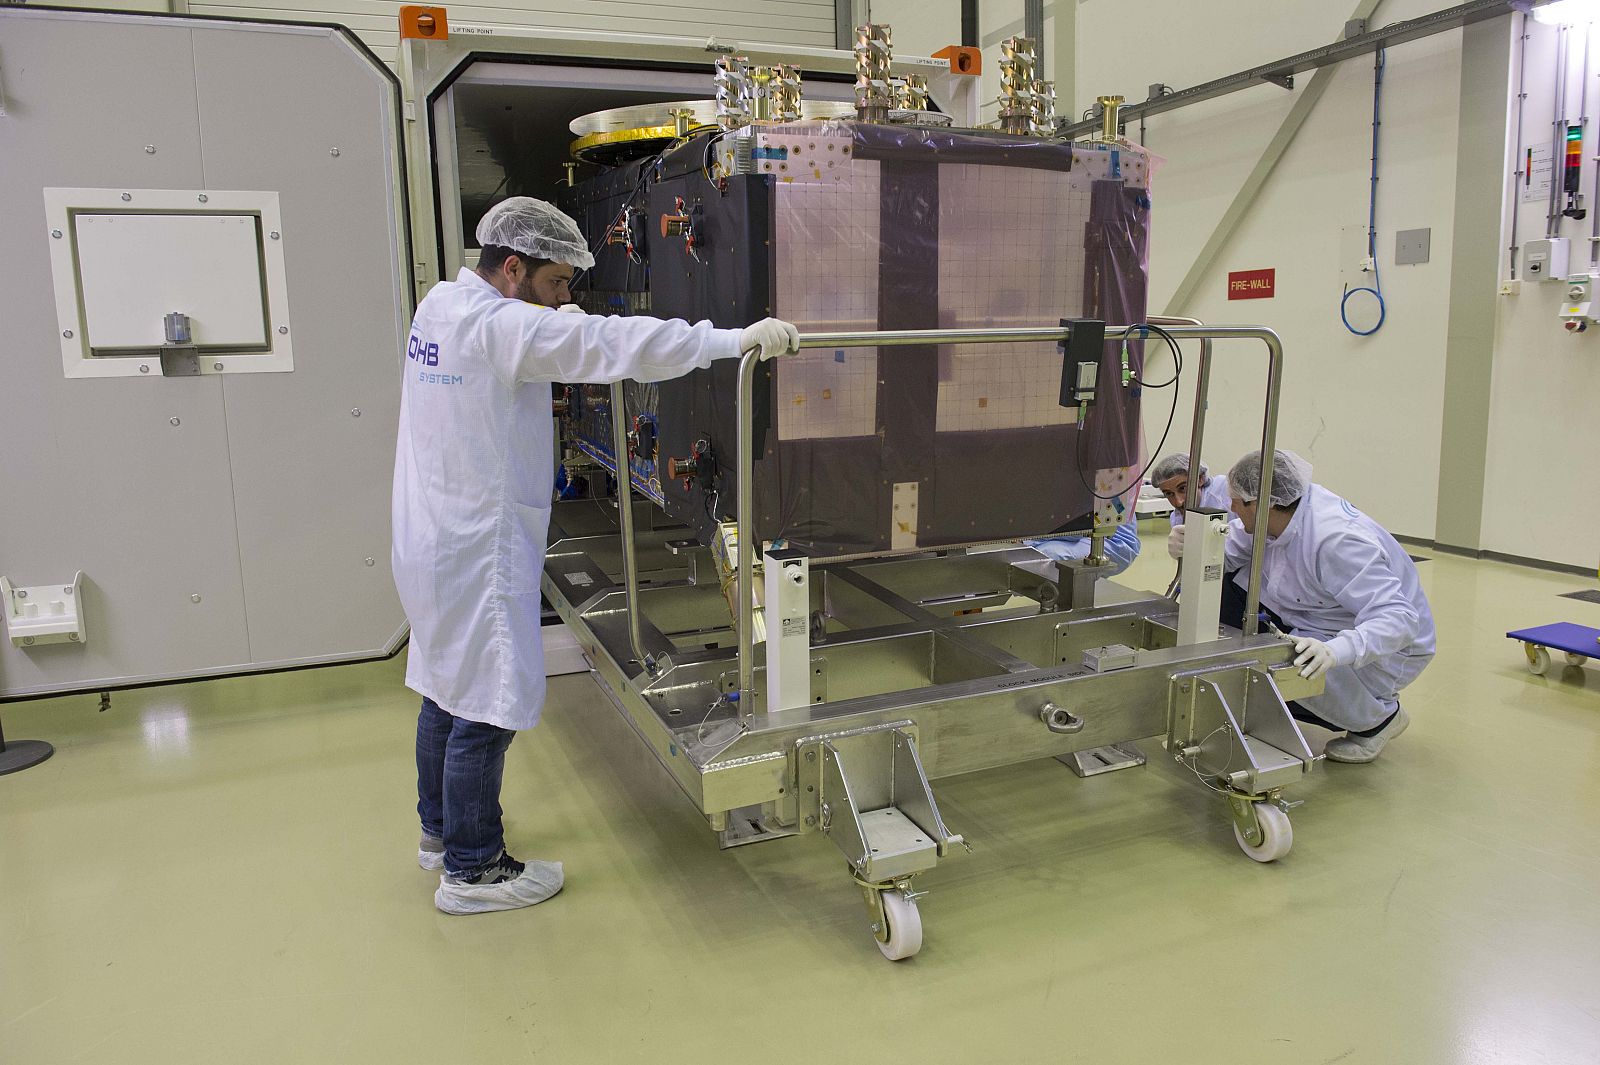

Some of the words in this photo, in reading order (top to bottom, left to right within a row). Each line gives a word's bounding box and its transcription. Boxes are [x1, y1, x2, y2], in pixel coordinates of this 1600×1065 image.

[1231, 279, 1271, 291] FIRE-WALL
[408, 334, 439, 367] OHB
[419, 371, 463, 385] SYSTEM
